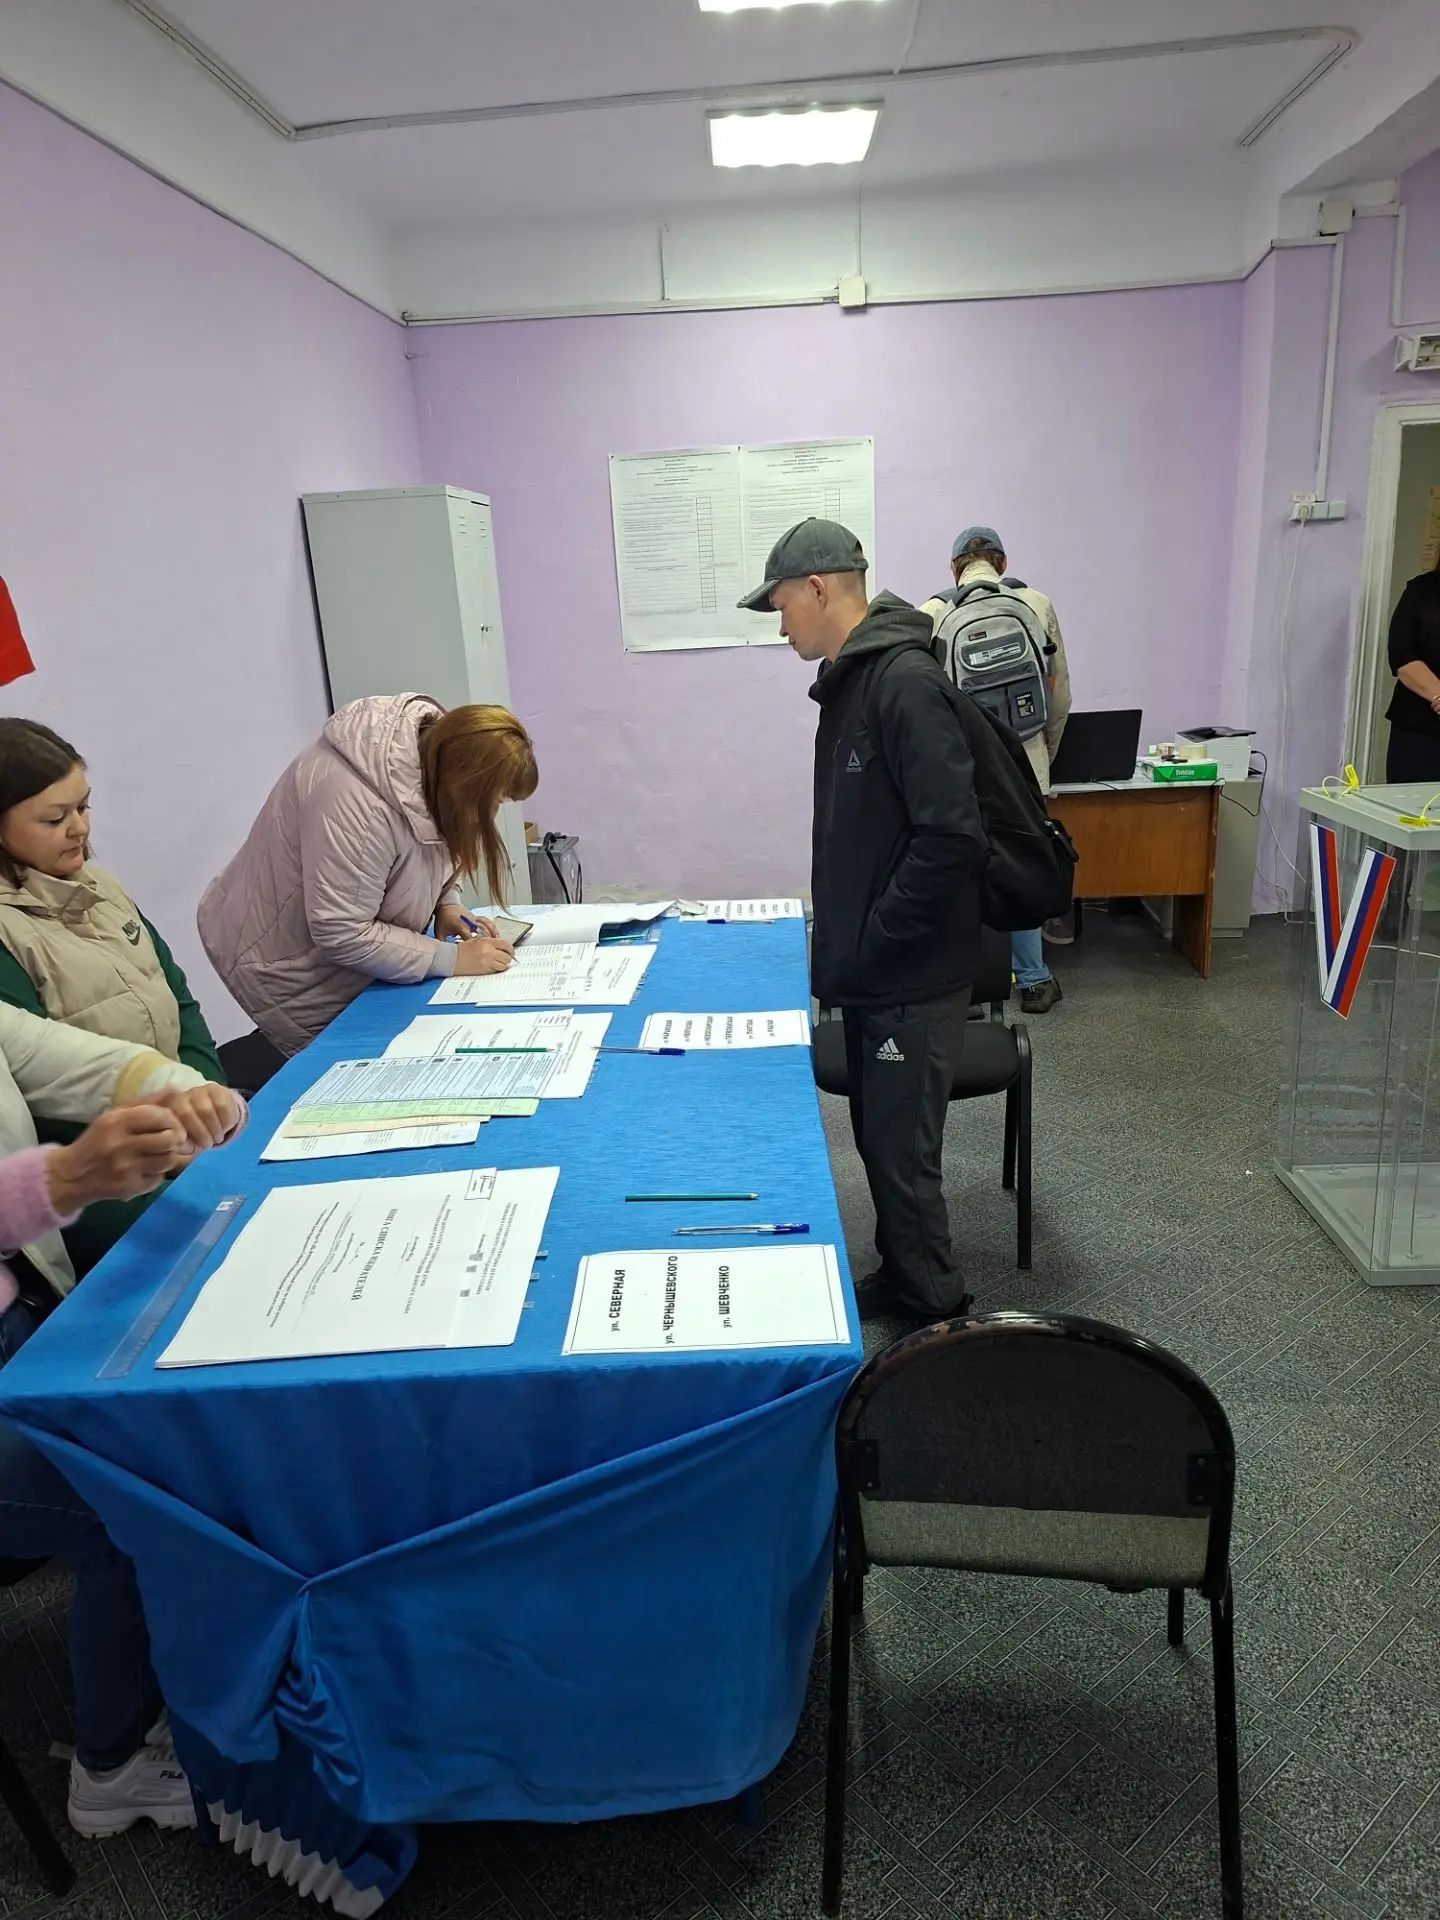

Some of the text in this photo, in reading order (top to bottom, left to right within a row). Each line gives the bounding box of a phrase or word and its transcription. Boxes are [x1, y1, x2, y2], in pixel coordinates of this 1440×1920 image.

[876, 1052, 905, 1061] adidas
[608, 1269, 626, 1332] ул. СЕВЕРНАЯ
[663, 1255, 678, 1344] ул. ЧЕРНЫШЕВСКОГО
[718, 1265, 732, 1328] ул. ШЕВЧЕНКО
[160, 1770, 184, 1779] FILA
